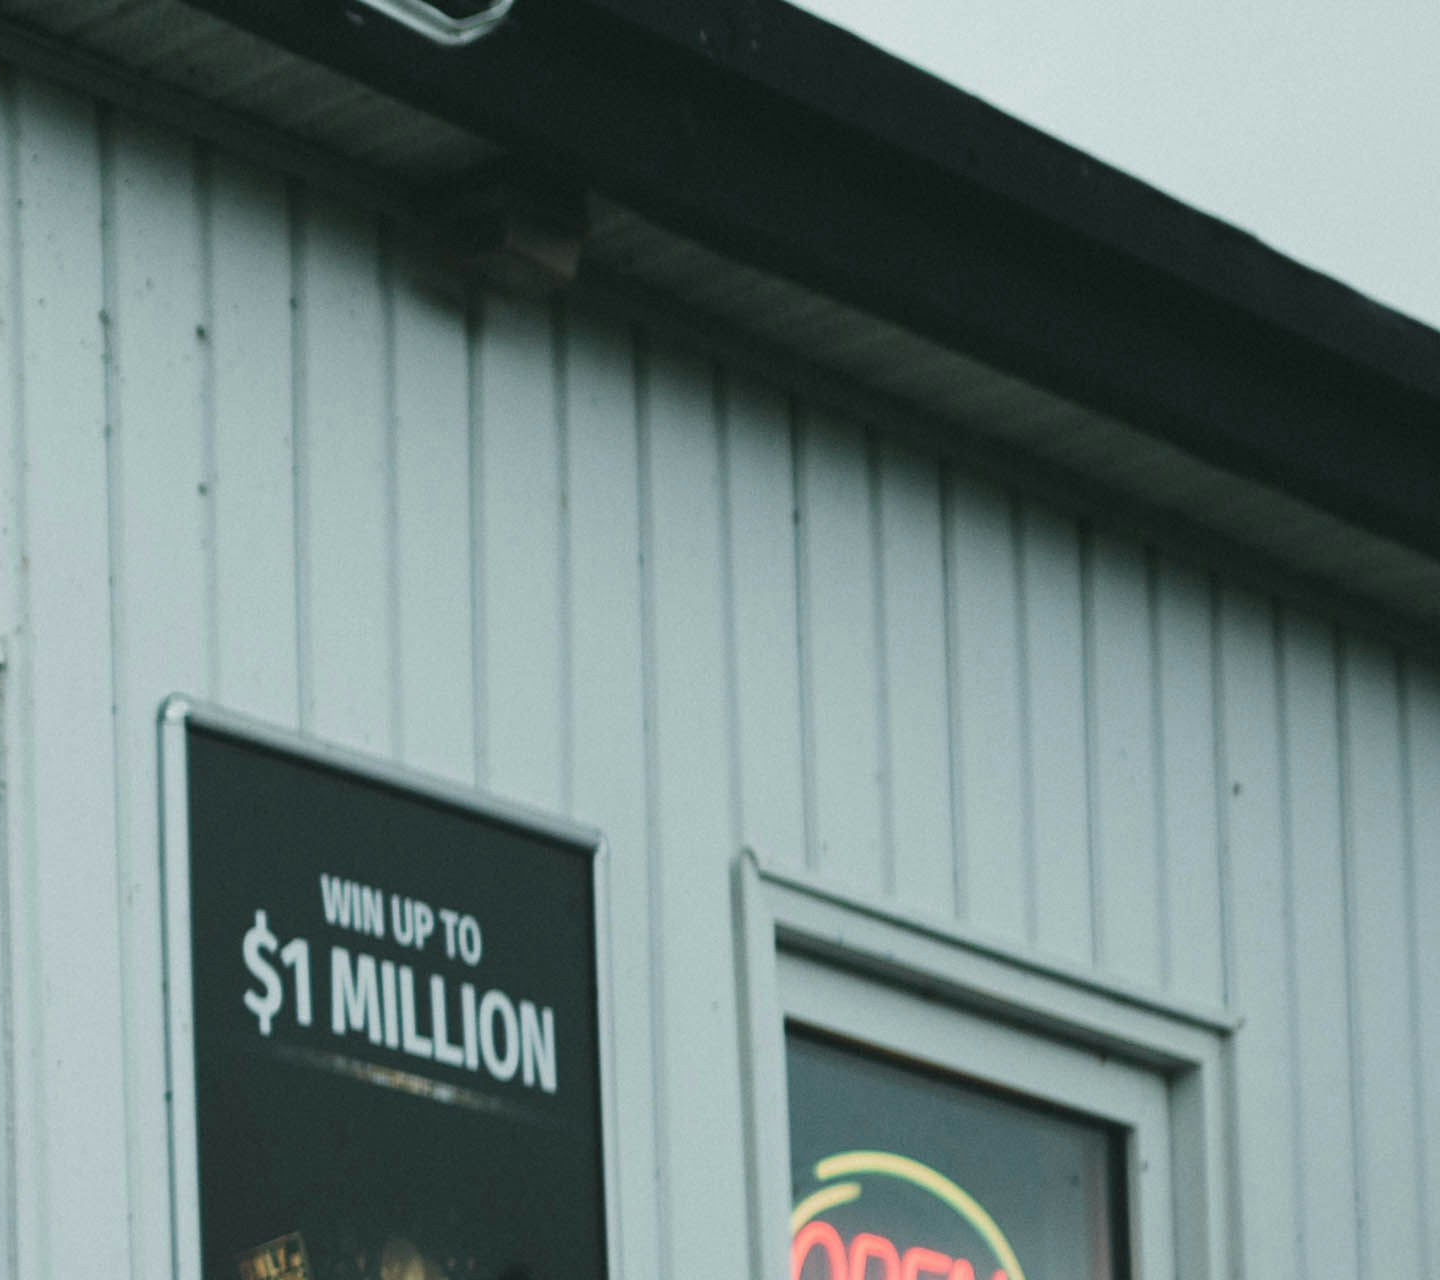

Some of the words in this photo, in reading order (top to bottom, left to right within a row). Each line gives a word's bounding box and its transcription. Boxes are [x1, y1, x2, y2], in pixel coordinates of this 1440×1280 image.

[320, 873, 385, 939] WIN
[390, 894, 435, 950] UP
[439, 908, 483, 966] TO
[241, 908, 313, 1037] $1
[330, 942, 558, 1094] MILLION
